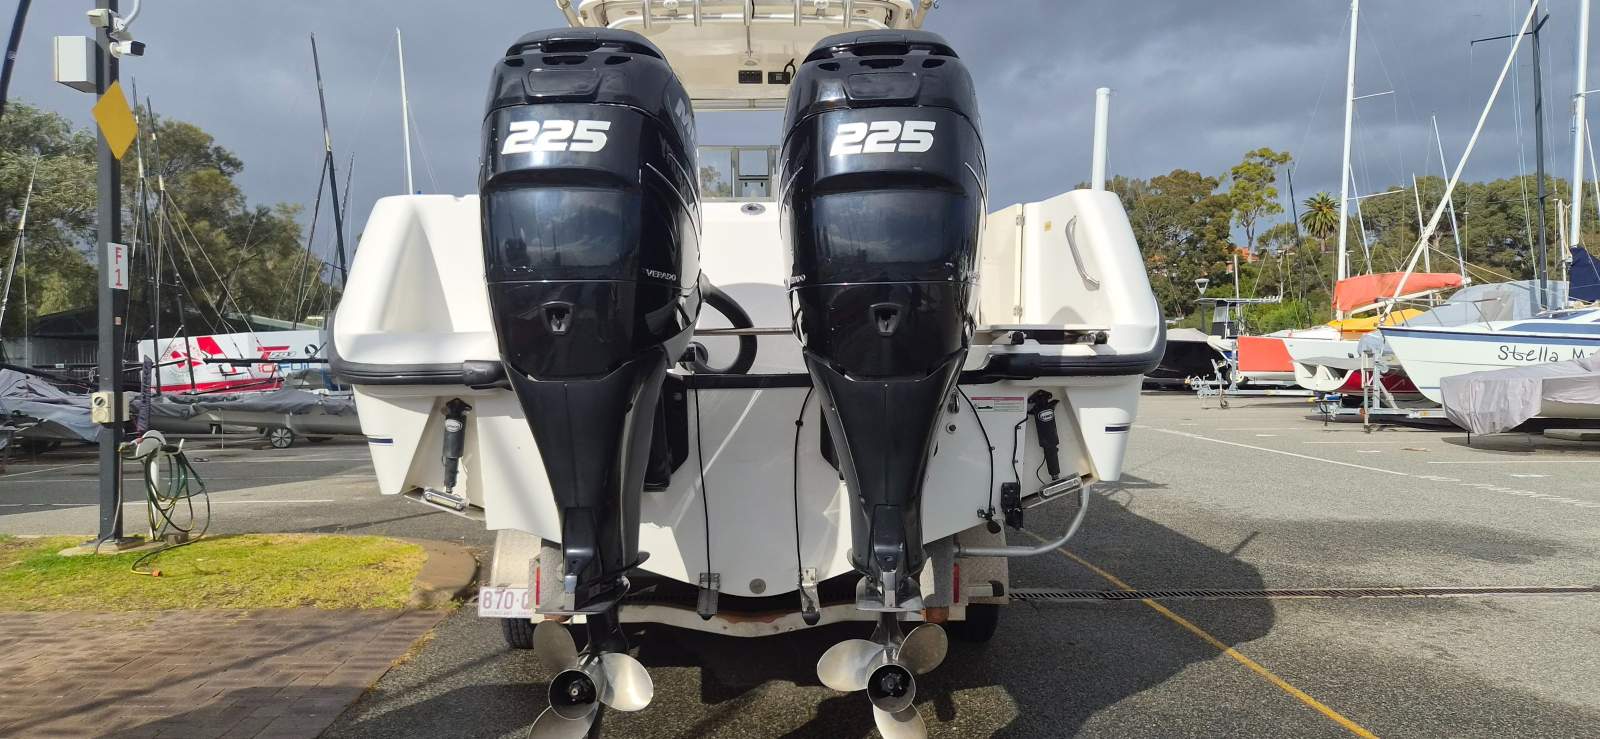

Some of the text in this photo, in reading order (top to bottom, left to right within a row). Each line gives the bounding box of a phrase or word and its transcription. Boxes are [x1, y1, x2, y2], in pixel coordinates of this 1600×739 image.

[501, 119, 612, 155] 225
[829, 120, 937, 157] 225
[1498, 345, 1559, 362] Stella
